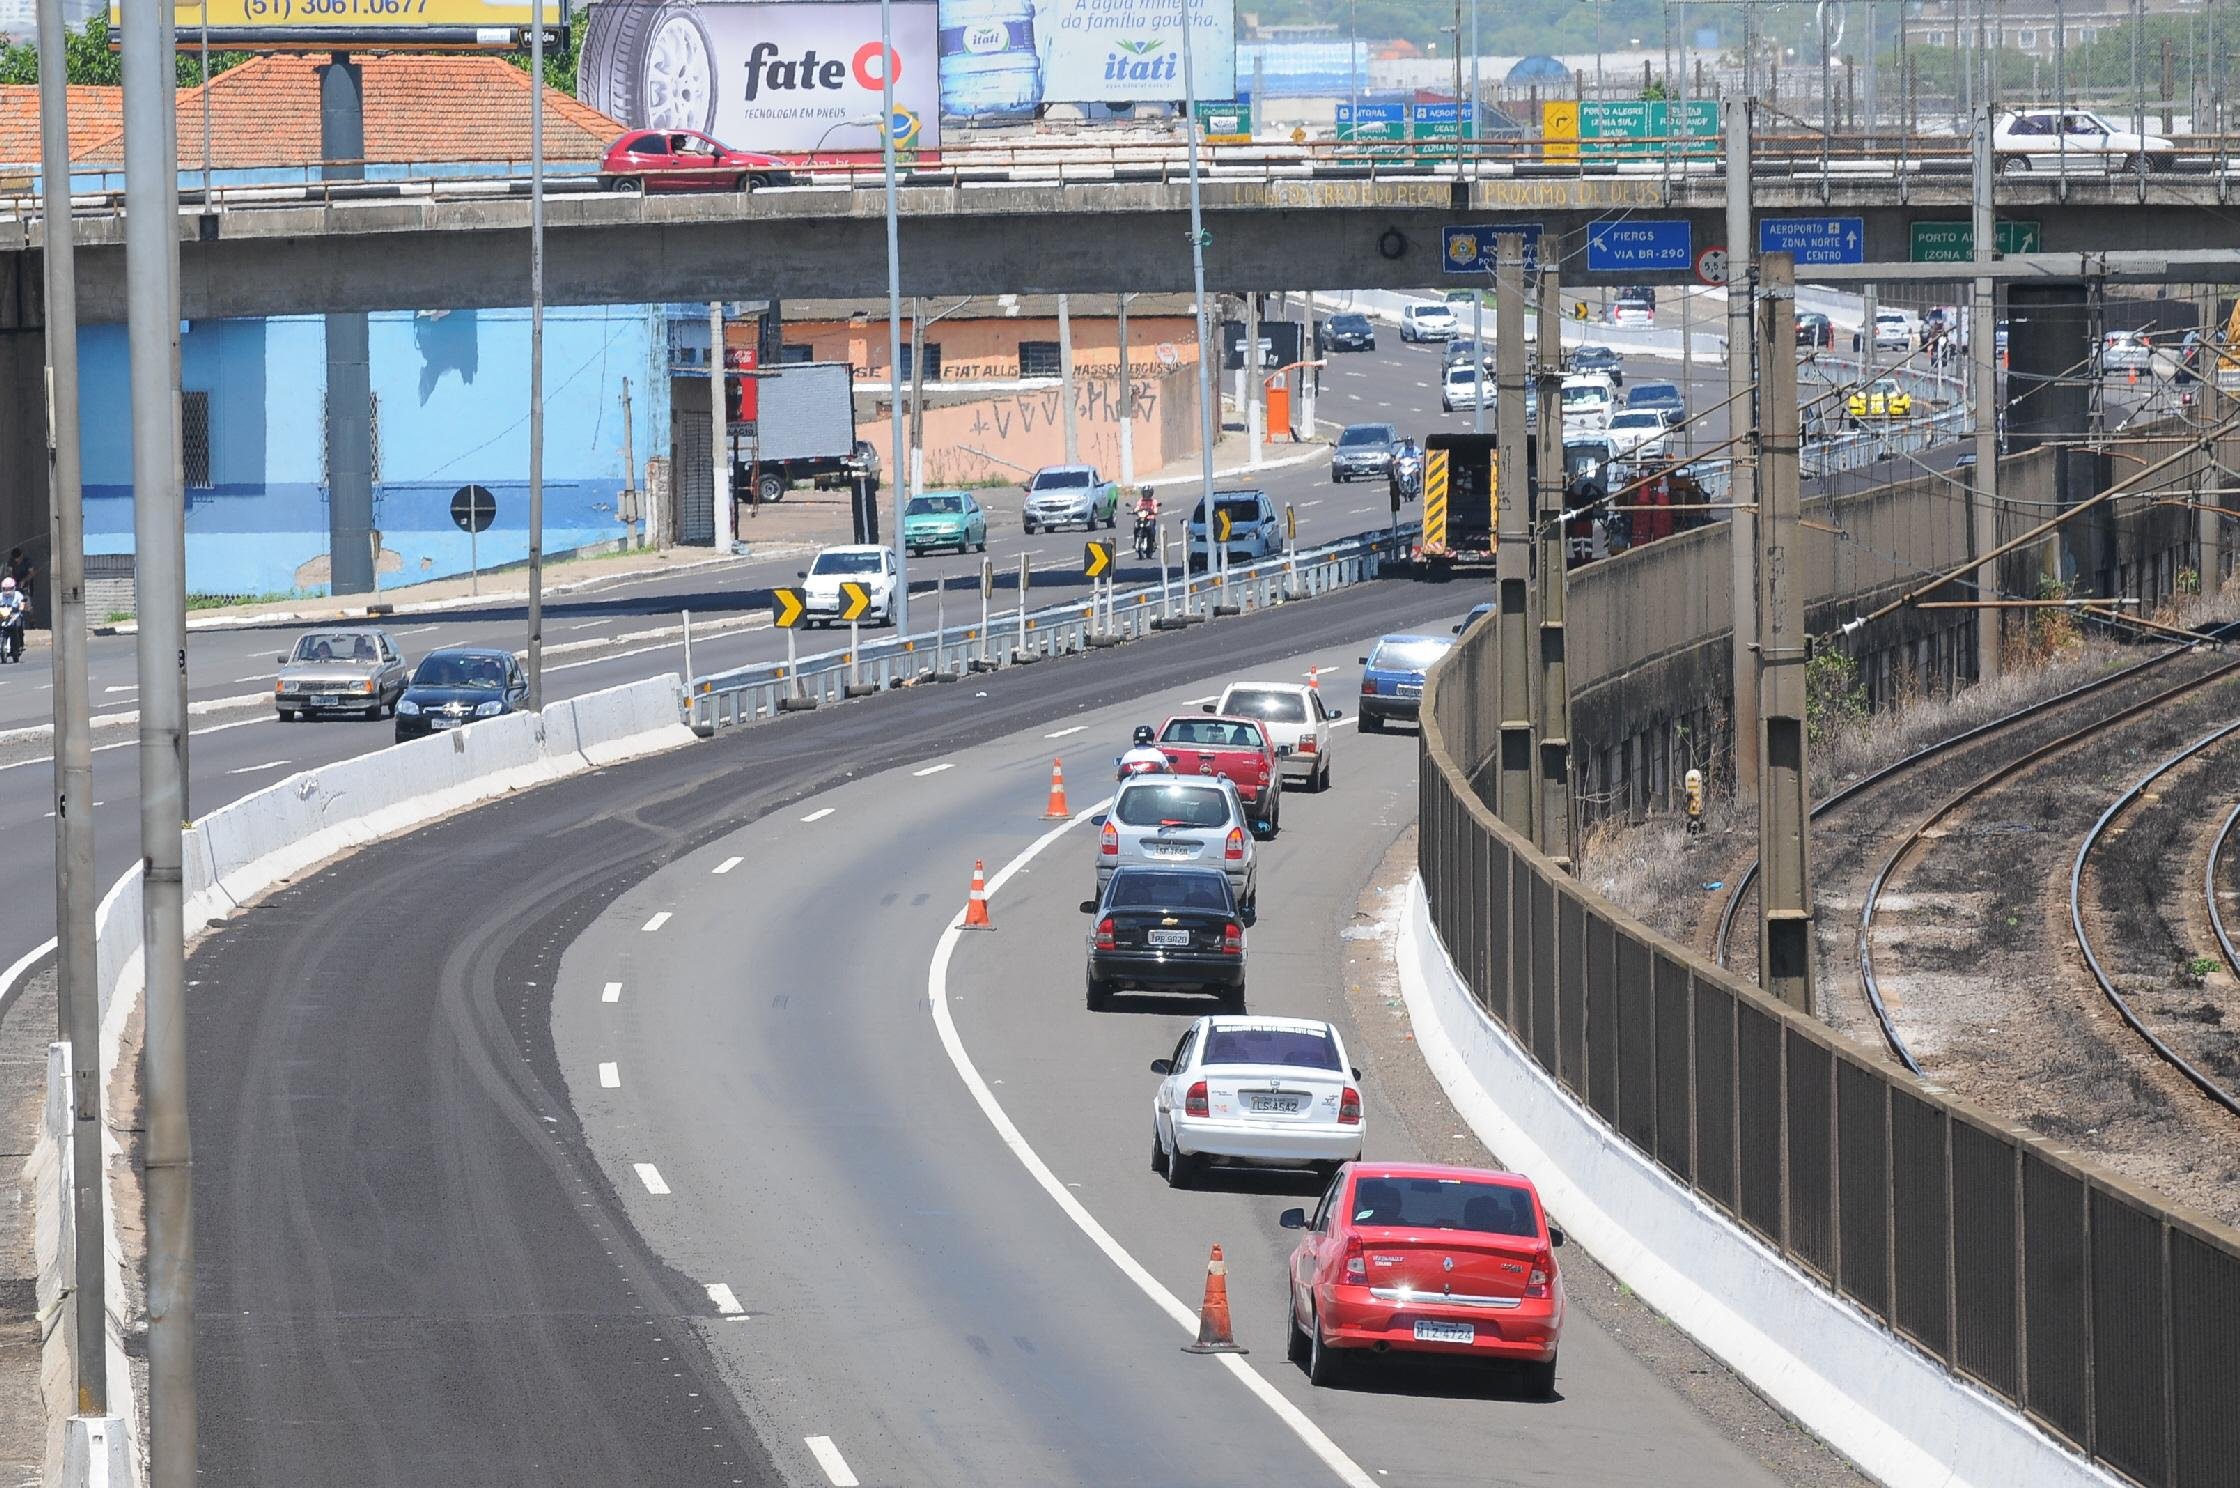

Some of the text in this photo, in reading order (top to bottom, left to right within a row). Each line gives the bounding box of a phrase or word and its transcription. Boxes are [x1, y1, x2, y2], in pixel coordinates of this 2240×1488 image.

[243, 0, 427, 20] (51) 3061.0677
[1060, 13, 1082, 29] da
[1086, 11, 1146, 32] família
[972, 33, 999, 45] itati
[744, 42, 846, 101] fate
[1104, 52, 1177, 81] itati
[744, 107, 847, 119] TECNOLOGIA EM PNEUS
[1612, 107, 1644, 116] ALEGRE
[1769, 224, 1823, 235] AEROPORTO
[1613, 231, 1655, 241] FIERGS
[1917, 231, 1957, 243] PORTO
[1782, 237, 1841, 248] ZONA NORTE
[1614, 248, 1685, 260] VIA BR-290
[1806, 250, 1841, 261] CENTRO
[1924, 249, 1960, 261] (ZONA
[943, 364, 1018, 378] FIAT ALLIS
[1072, 363, 1120, 376] MASSEY
